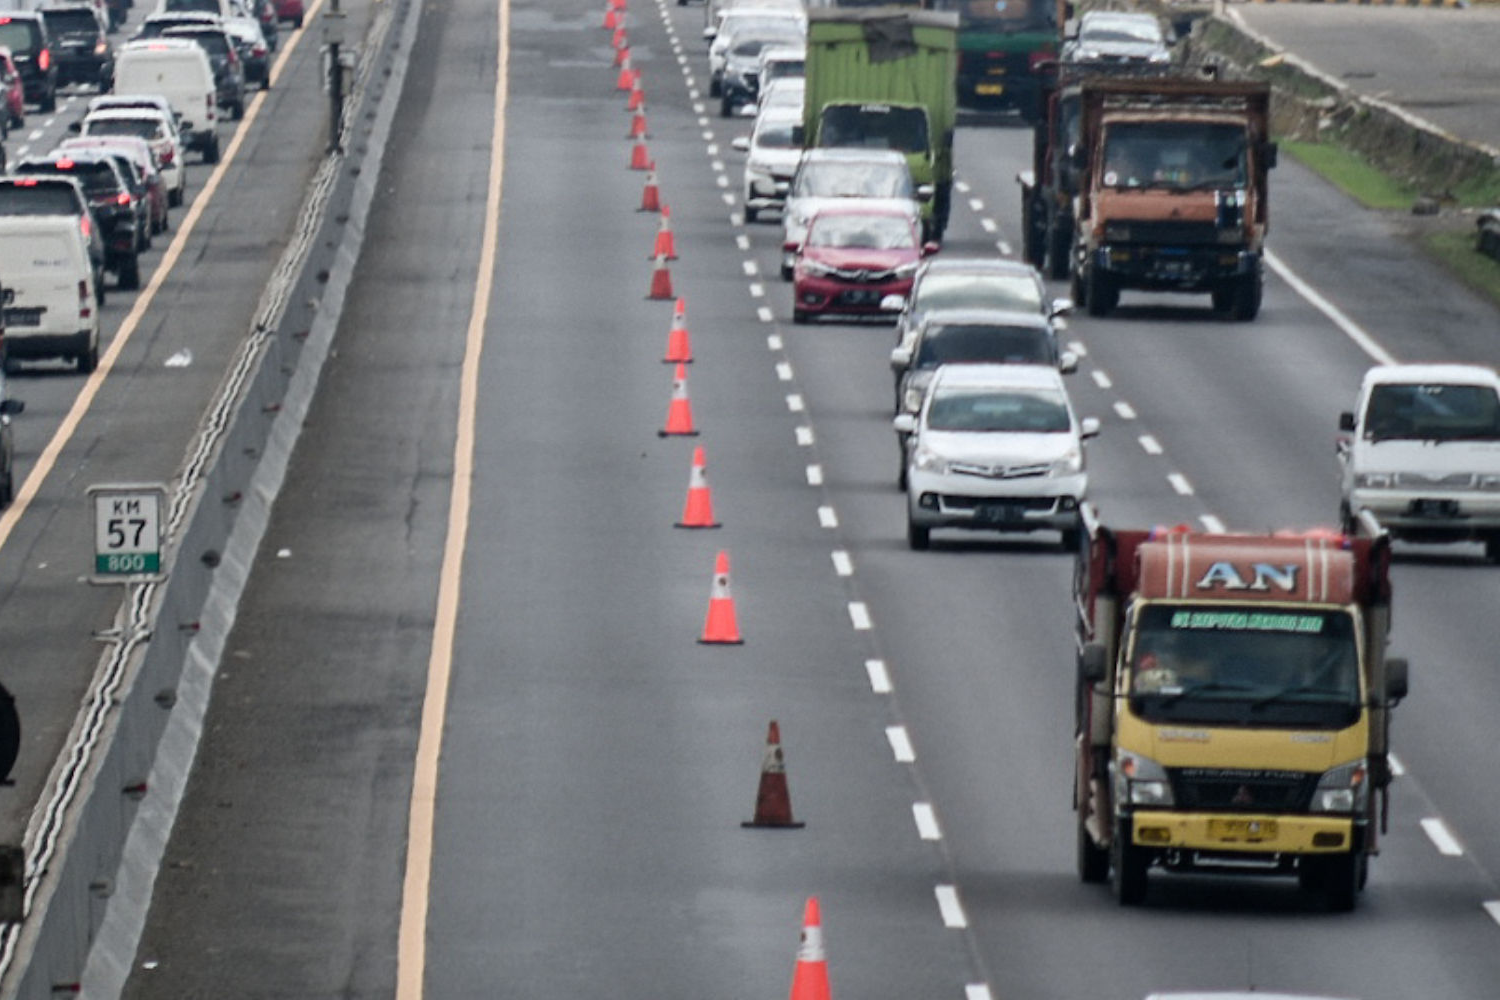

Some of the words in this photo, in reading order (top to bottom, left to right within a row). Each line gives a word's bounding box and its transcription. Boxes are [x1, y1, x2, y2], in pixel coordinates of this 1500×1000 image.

[113, 499, 140, 515] KM
[108, 519, 147, 549] 57
[108, 555, 146, 571] 800
[1196, 561, 1300, 592] AN
